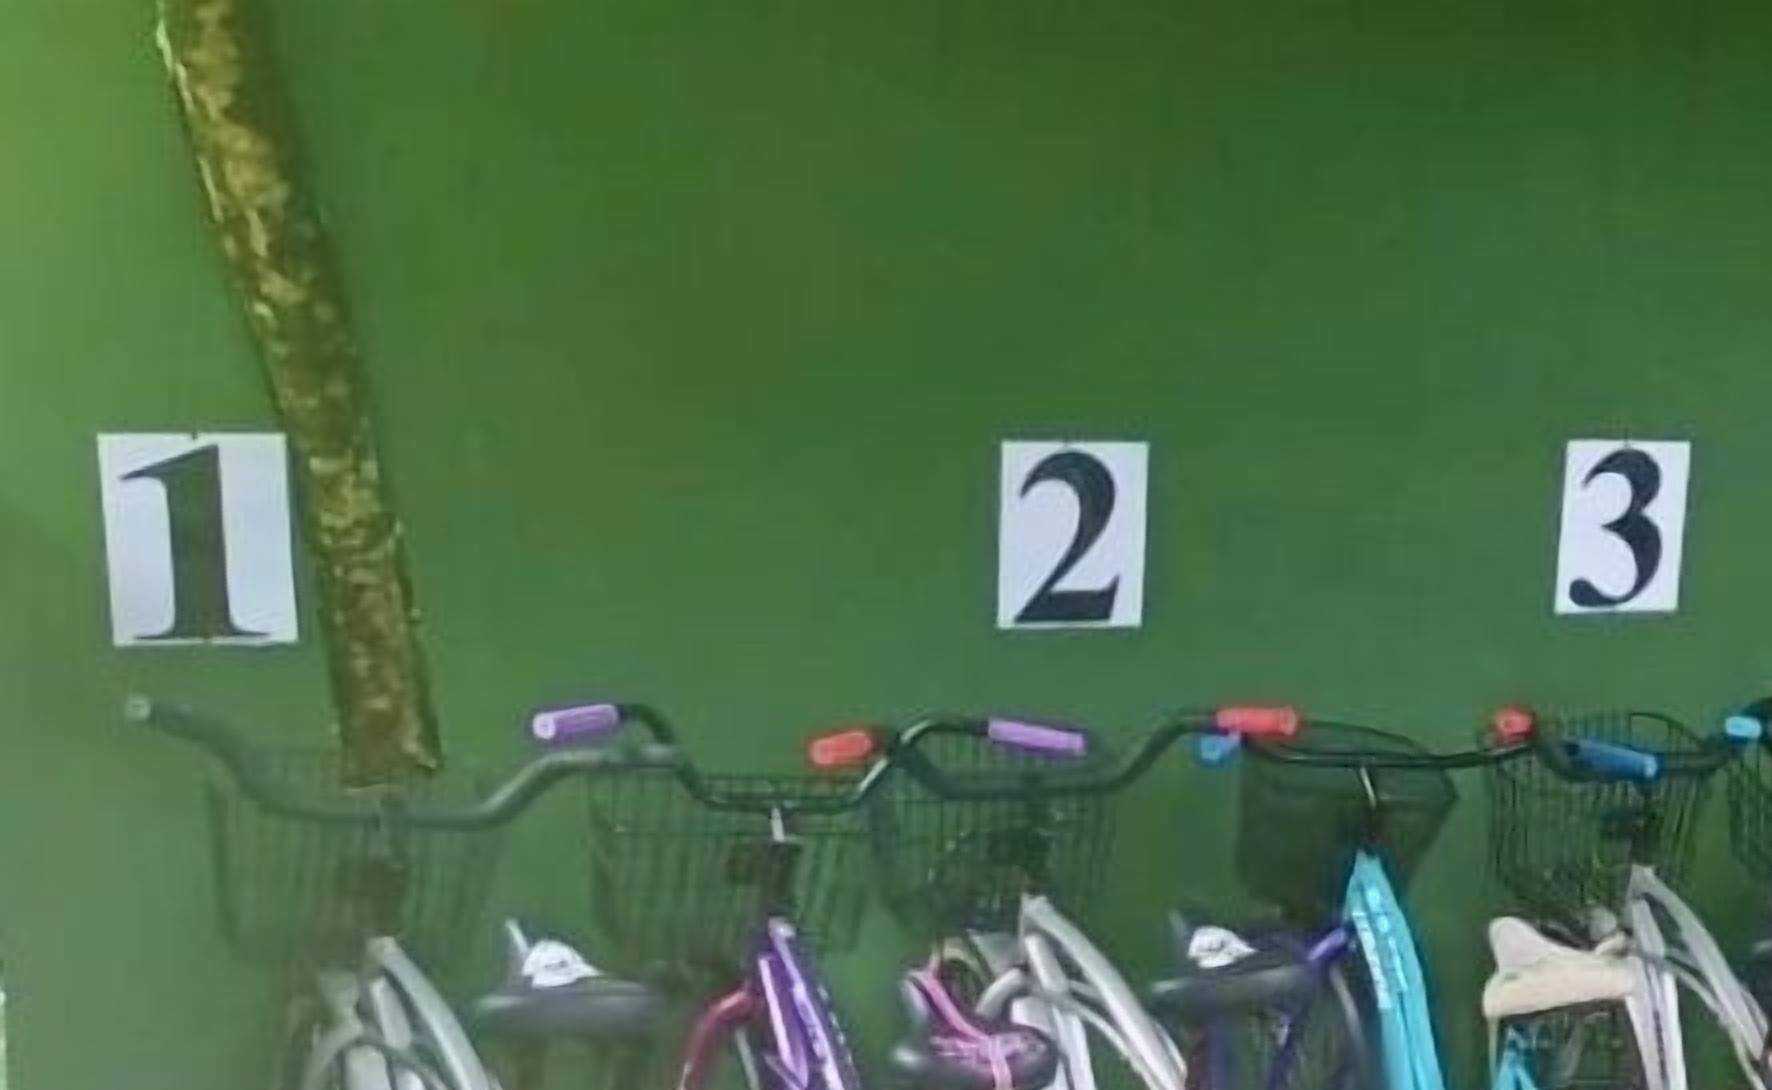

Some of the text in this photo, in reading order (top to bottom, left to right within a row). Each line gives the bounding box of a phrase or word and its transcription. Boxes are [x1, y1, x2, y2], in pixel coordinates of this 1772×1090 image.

[121, 443, 270, 641] 1
[1013, 450, 1120, 625] 2
[1569, 448, 1662, 608] 3
